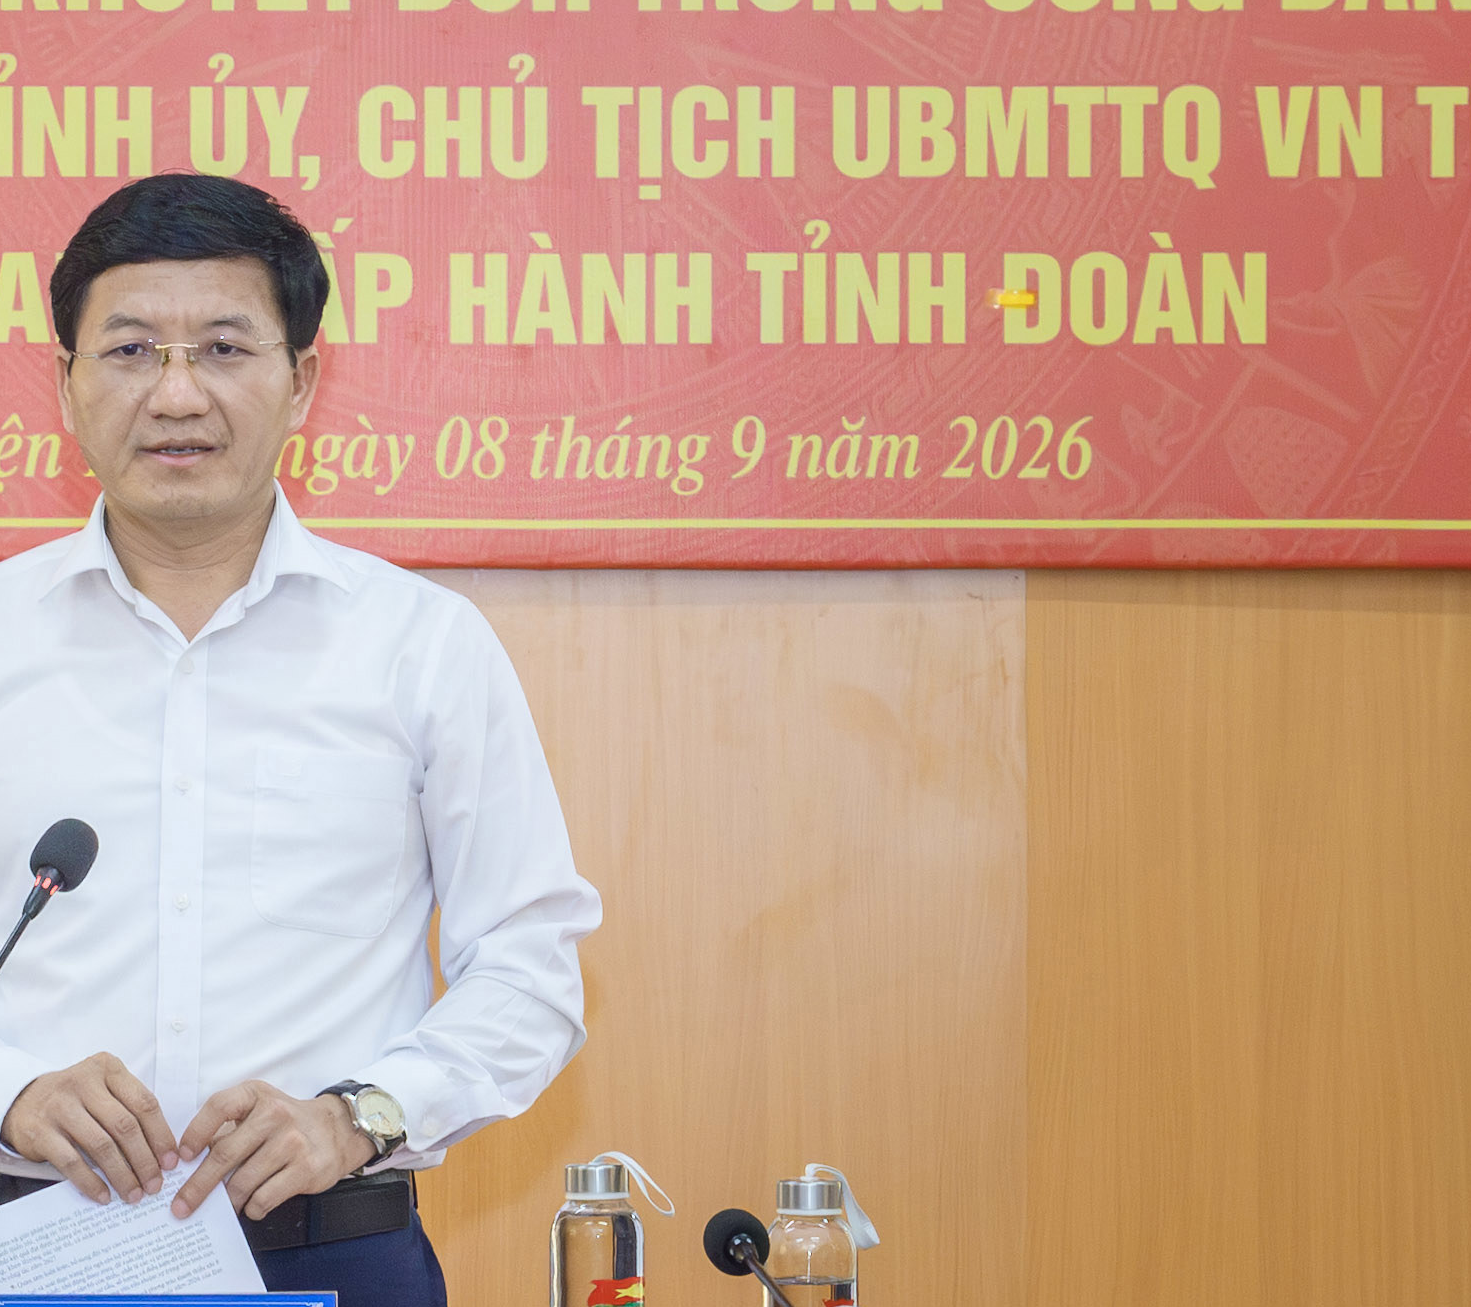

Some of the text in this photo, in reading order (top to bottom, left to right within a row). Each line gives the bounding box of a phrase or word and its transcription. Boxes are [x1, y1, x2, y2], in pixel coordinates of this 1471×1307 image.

[190, 54, 320, 190] ỦY,
[358, 55, 547, 179] CHỦ
[582, 85, 795, 200] TỊCH
[832, 85, 1221, 190] UBMTTQ
[1255, 85, 1383, 178] VN
[449, 233, 712, 344] HÀNH
[746, 220, 966, 344] TỈNH
[1004, 232, 1267, 346] ĐOÀN
[273, 414, 416, 496] ngày
[435, 415, 509, 479] 08
[531, 415, 710, 496] tháng
[732, 416, 765, 478] 9
[786, 416, 919, 479] năm
[942, 416, 1092, 480] 2026
